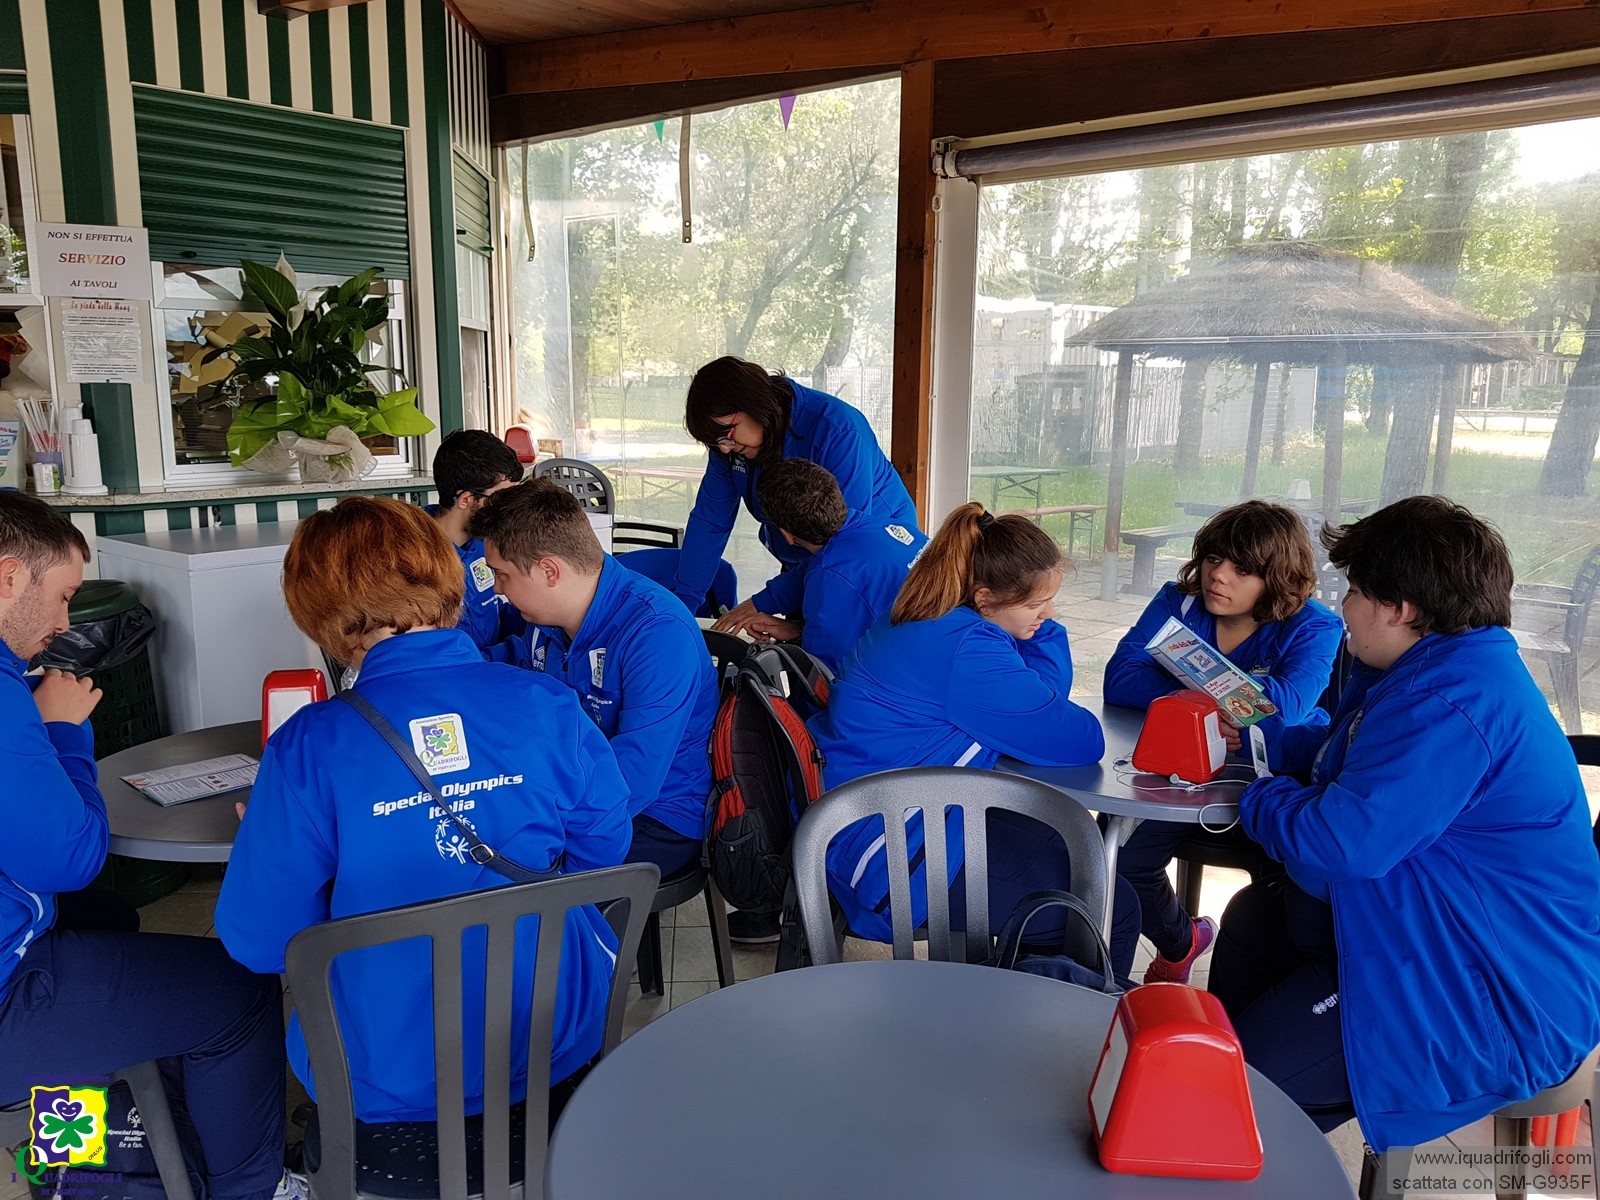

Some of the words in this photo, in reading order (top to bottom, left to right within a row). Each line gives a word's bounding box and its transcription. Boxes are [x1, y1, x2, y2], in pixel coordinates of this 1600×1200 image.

[47, 231, 70, 240] NON
[73, 232, 83, 240] SI
[85, 233, 133, 243] EFFETTUA
[58, 252, 126, 266] SERVIZIO
[83, 280, 118, 289] TAVOLI
[372, 791, 434, 816] Specia
[441, 774, 524, 797] Olympics
